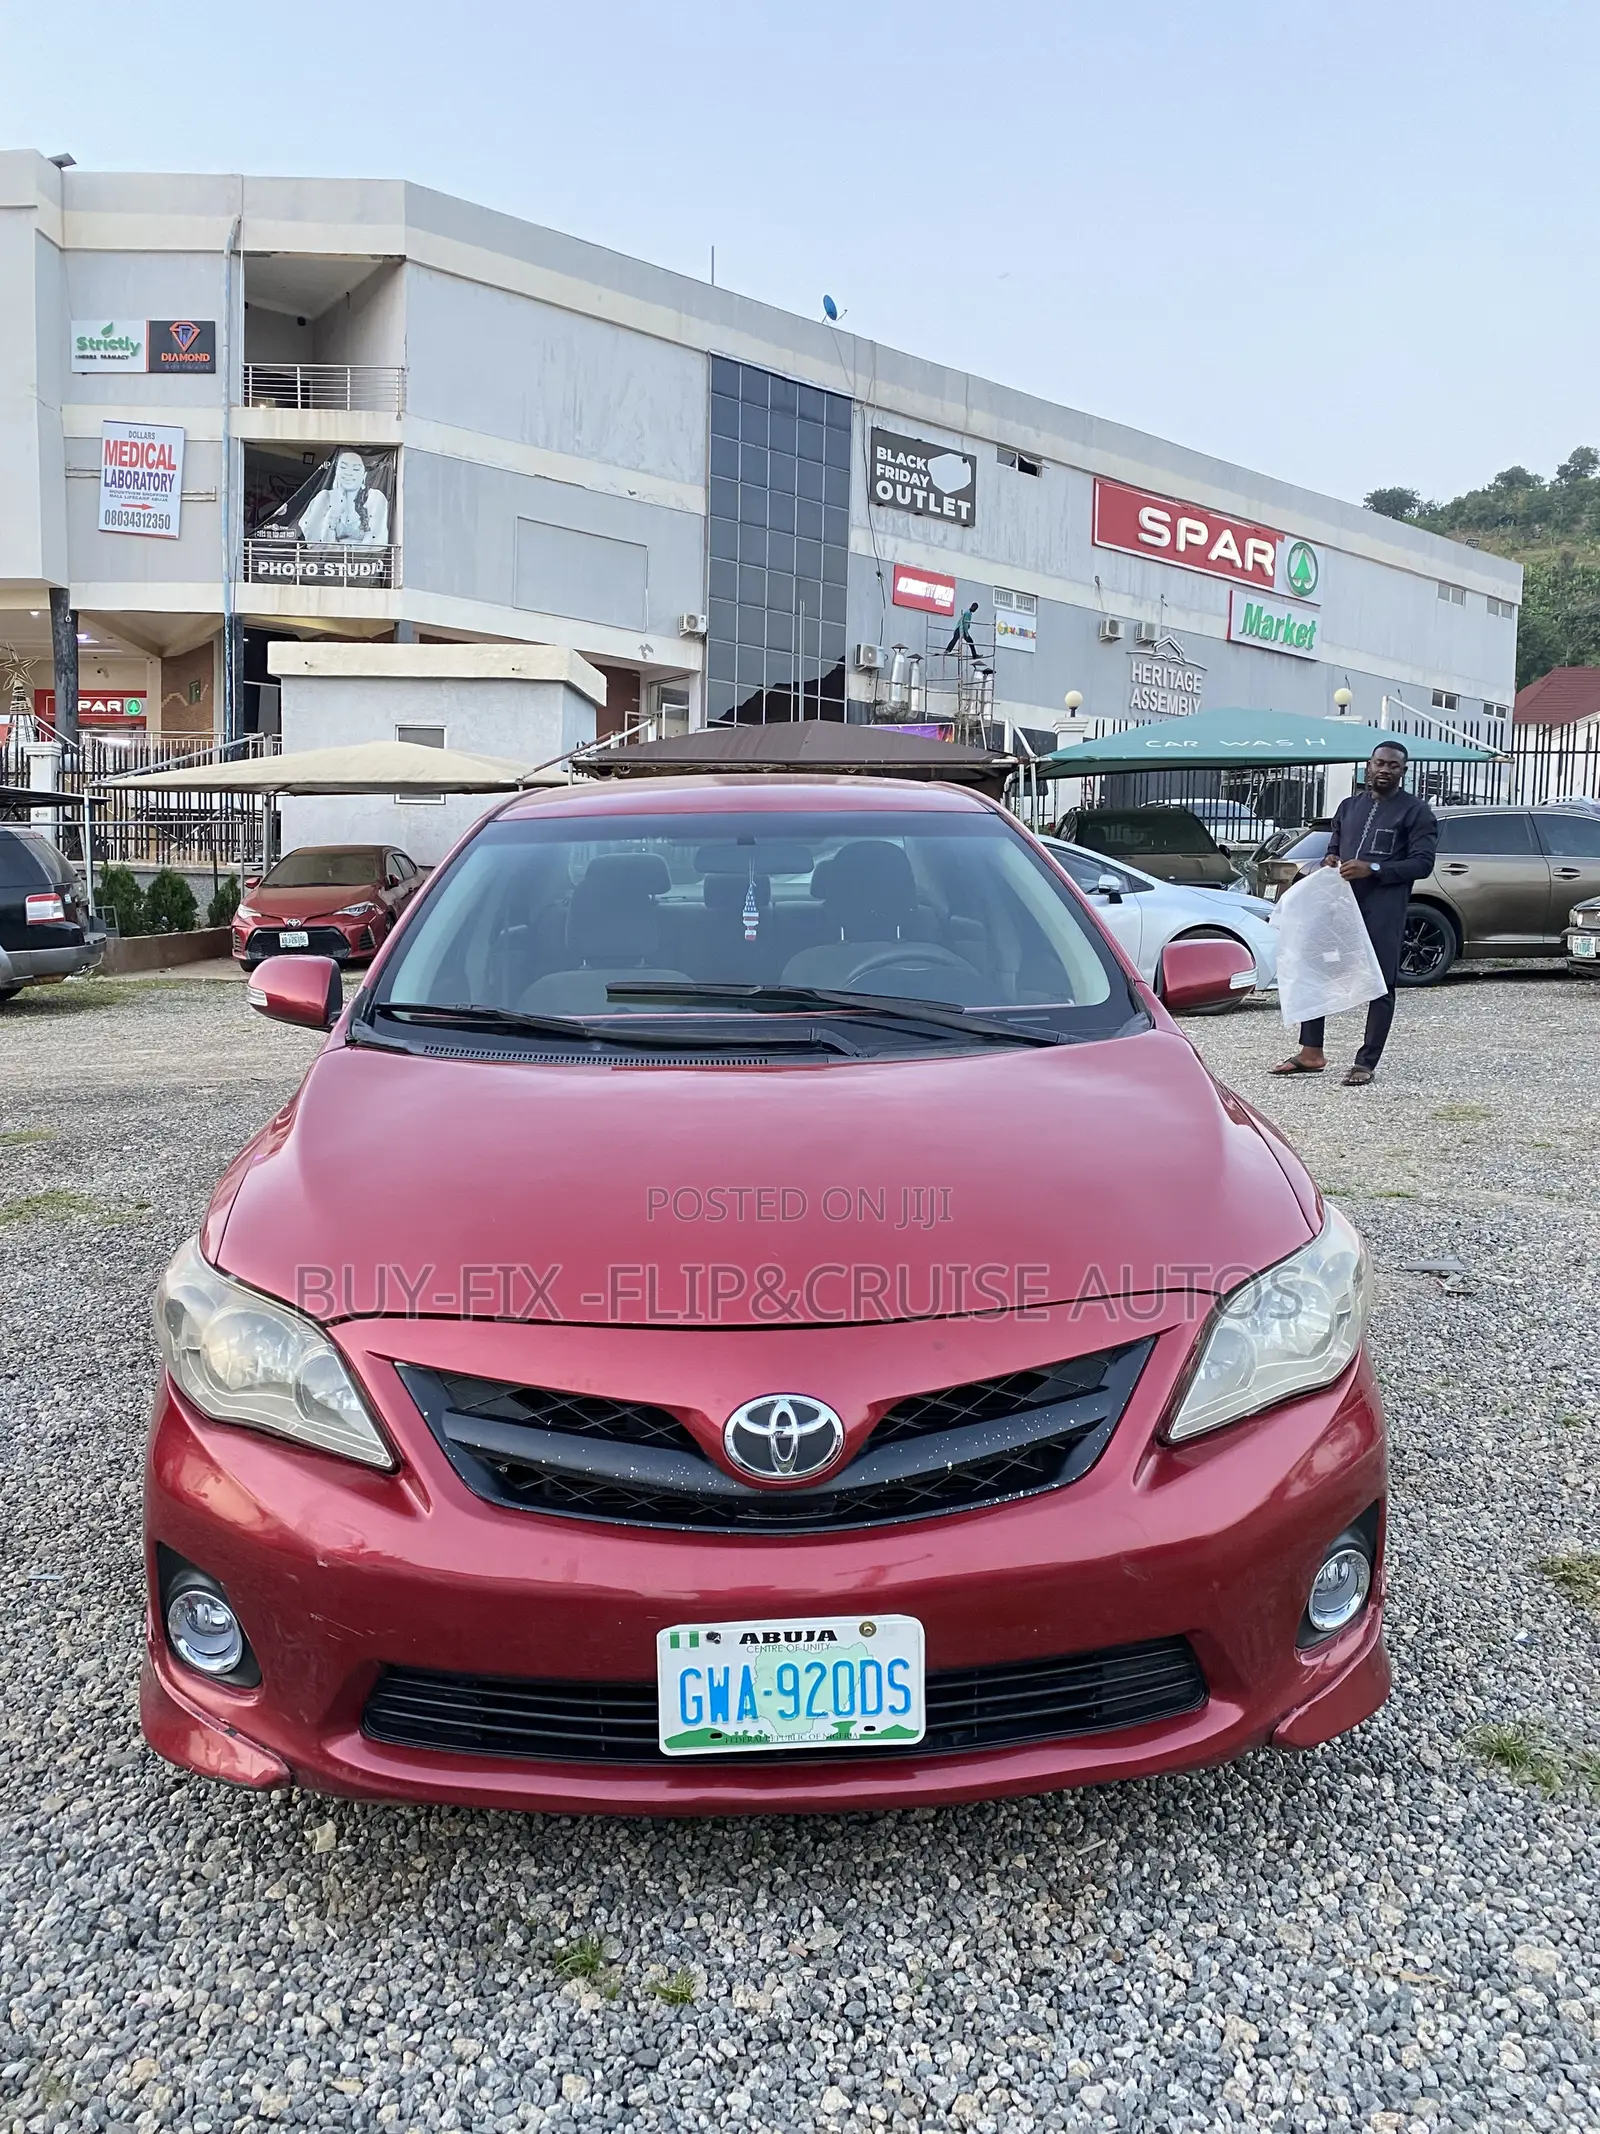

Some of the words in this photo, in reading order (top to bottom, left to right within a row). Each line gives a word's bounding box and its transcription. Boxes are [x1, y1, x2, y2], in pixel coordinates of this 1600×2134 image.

[76, 336, 141, 357] Strictly
[161, 353, 210, 363] DIAMOND
[128, 430, 156, 440] DOLLARS
[104, 439, 177, 471] MEDICAL
[876, 445, 927, 471] BLACK
[103, 468, 175, 493] LABORATORY
[876, 462, 930, 488] FRIDAY
[875, 480, 971, 520] OUTLET
[104, 509, 171, 530] 08034312350
[1137, 506, 1276, 577] SPAR
[258, 561, 318, 576] PHOTO
[1239, 602, 1317, 651] Market
[1130, 661, 1203, 694] HERITAGE
[78, 700, 122, 712] PAR
[1129, 687, 1202, 717] ASSEMBLY
[1145, 740, 1199, 748] CAR
[1219, 737, 1327, 748] WASH
[739, 1630, 838, 1645] ABUJA
[746, 1644, 783, 1654] CENTRE
[786, 1644, 802, 1652] OF
[803, 1642, 831, 1651] UNITY
[679, 1658, 912, 1726] GWA-920DS
[808, 1732, 821, 1741] OF
